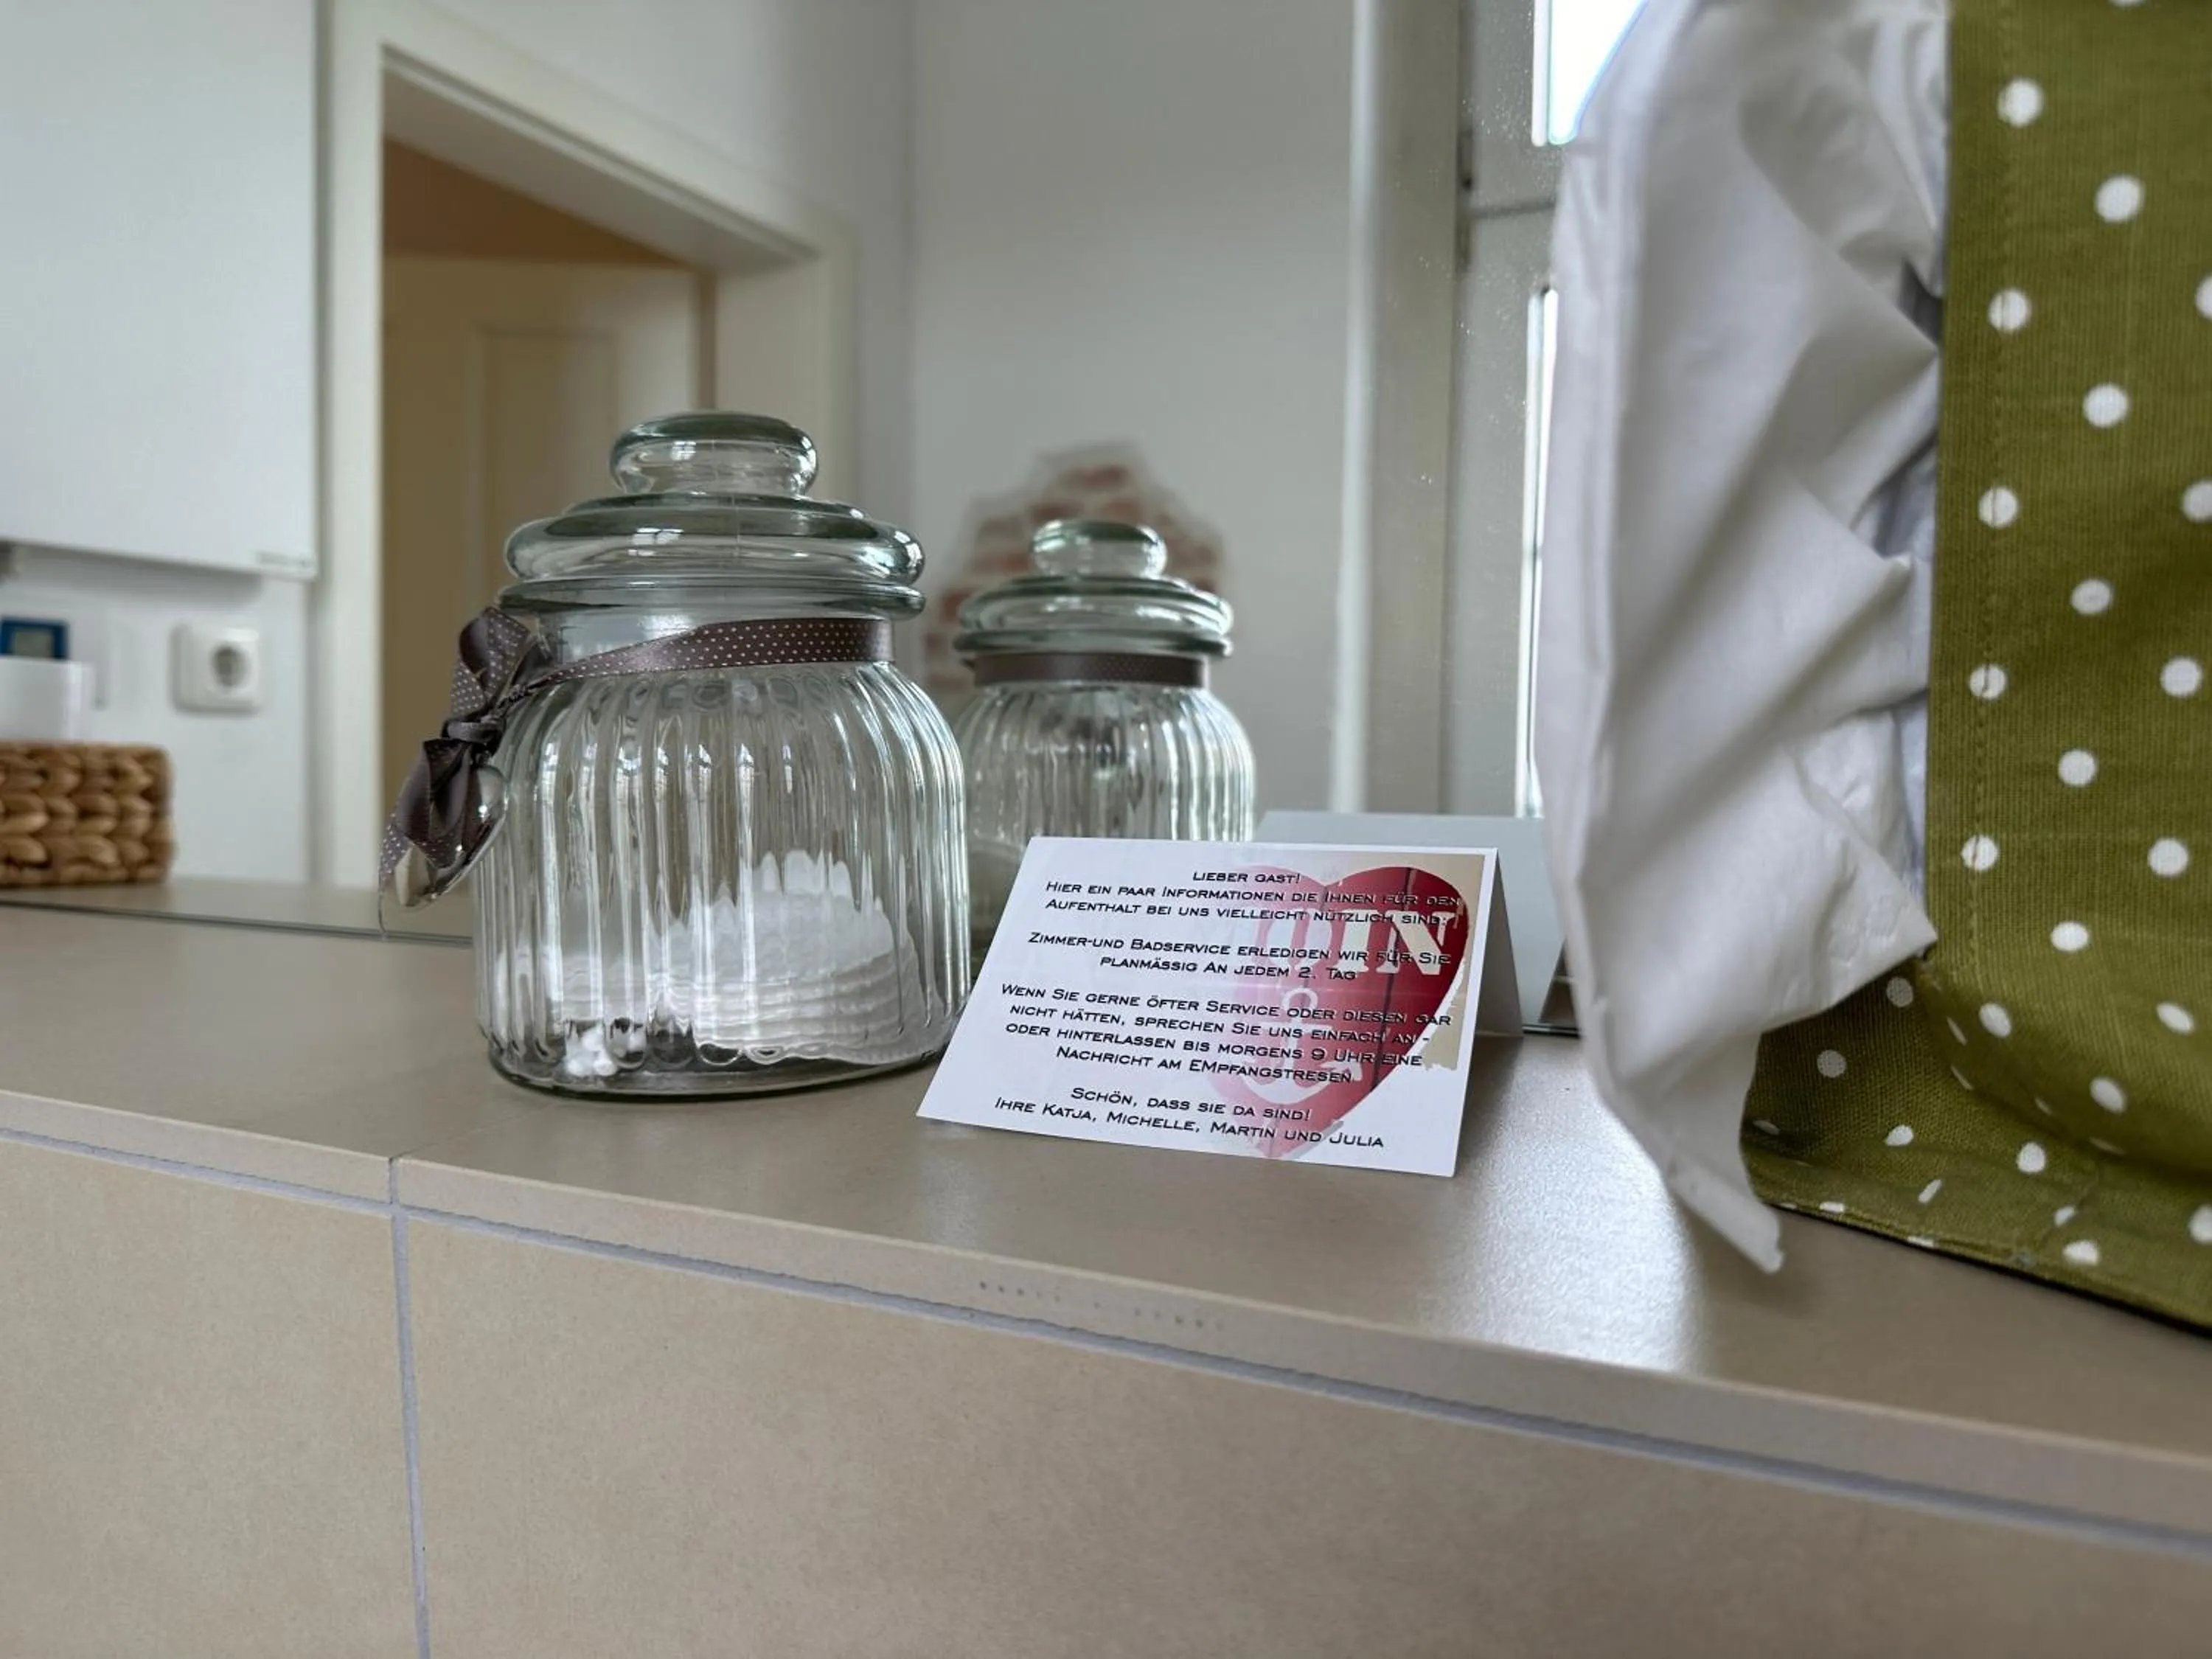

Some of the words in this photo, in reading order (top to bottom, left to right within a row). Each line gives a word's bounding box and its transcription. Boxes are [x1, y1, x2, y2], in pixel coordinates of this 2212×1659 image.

[1045, 880, 1083, 894] HIER
[1088, 885, 1112, 895] EIN
[1117, 886, 1156, 897] PAAR
[1161, 887, 1284, 902] INFORMATIONEN
[1291, 892, 1318, 902] DIE
[1325, 891, 1376, 905] IHNEN
[1192, 870, 1249, 883] LIEBER
[1254, 873, 1301, 883] GAST!
[1045, 898, 1142, 915] AUFENTHALT
[1146, 904, 1172, 916] BEI
[1178, 905, 1210, 917] UNS
[1217, 908, 1310, 921] VIELLEICHT
[1312, 910, 1394, 923] NÜTZLICH
[1028, 931, 1125, 950] ZIMMER-UND
[1130, 939, 1231, 956] BADSERVICE
[1237, 945, 1329, 959] ERLEDIGEN
[1338, 950, 1368, 962] WIR
[1419, 952, 1451, 965] SIE
[1099, 956, 1198, 972] PLANMÄSSIG
[1203, 961, 1228, 975] AN
[1233, 965, 1290, 977] JEDEM
[1001, 983, 1046, 998] WENN
[1051, 989, 1080, 1001] SIE
[1085, 992, 1141, 1007] GERNE
[1146, 995, 1200, 1012] ÖFTER
[1205, 1001, 1279, 1018] SERVICE
[1287, 1007, 1336, 1020] ODER
[1343, 1010, 1407, 1023] DIESEN
[1009, 1004, 1057, 1019] NICHT
[1062, 1009, 1125, 1026] HÄTTEN,
[1134, 1016, 1225, 1034] SPRECHEN
[1231, 1022, 1262, 1036] SIE
[1268, 1026, 1303, 1039] UNS
[1310, 1028, 1385, 1043] EINFACH
[1392, 1034, 1417, 1044] AN
[1006, 1023, 1051, 1037] ODER
[1057, 1029, 1176, 1049] HINTERLASSEN
[1183, 1040, 1210, 1053] BIS
[1217, 1043, 1303, 1060] MORGENS
[1311, 1047, 1326, 1060] 9
[1334, 1049, 1374, 1063] UHR
[1382, 1053, 1422, 1066] EINE
[1056, 1046, 1152, 1068] NACHRICHT
[1157, 1058, 1182, 1070] AM
[1071, 1087, 1138, 1107] SCHÖN,
[1147, 1097, 1190, 1111] DASS
[1197, 1102, 1227, 1115] SIE
[1233, 1105, 1256, 1117] DA
[1262, 1107, 1311, 1121] SIND!
[995, 1096, 1036, 1114] IHRE
[1042, 1103, 1097, 1122] KATJA,
[1106, 1110, 1200, 1133] MICHELLE,
[1210, 1122, 1277, 1139] MARTIN
[1284, 1128, 1323, 1142] UND
[1329, 1132, 1384, 1147] JULIA
